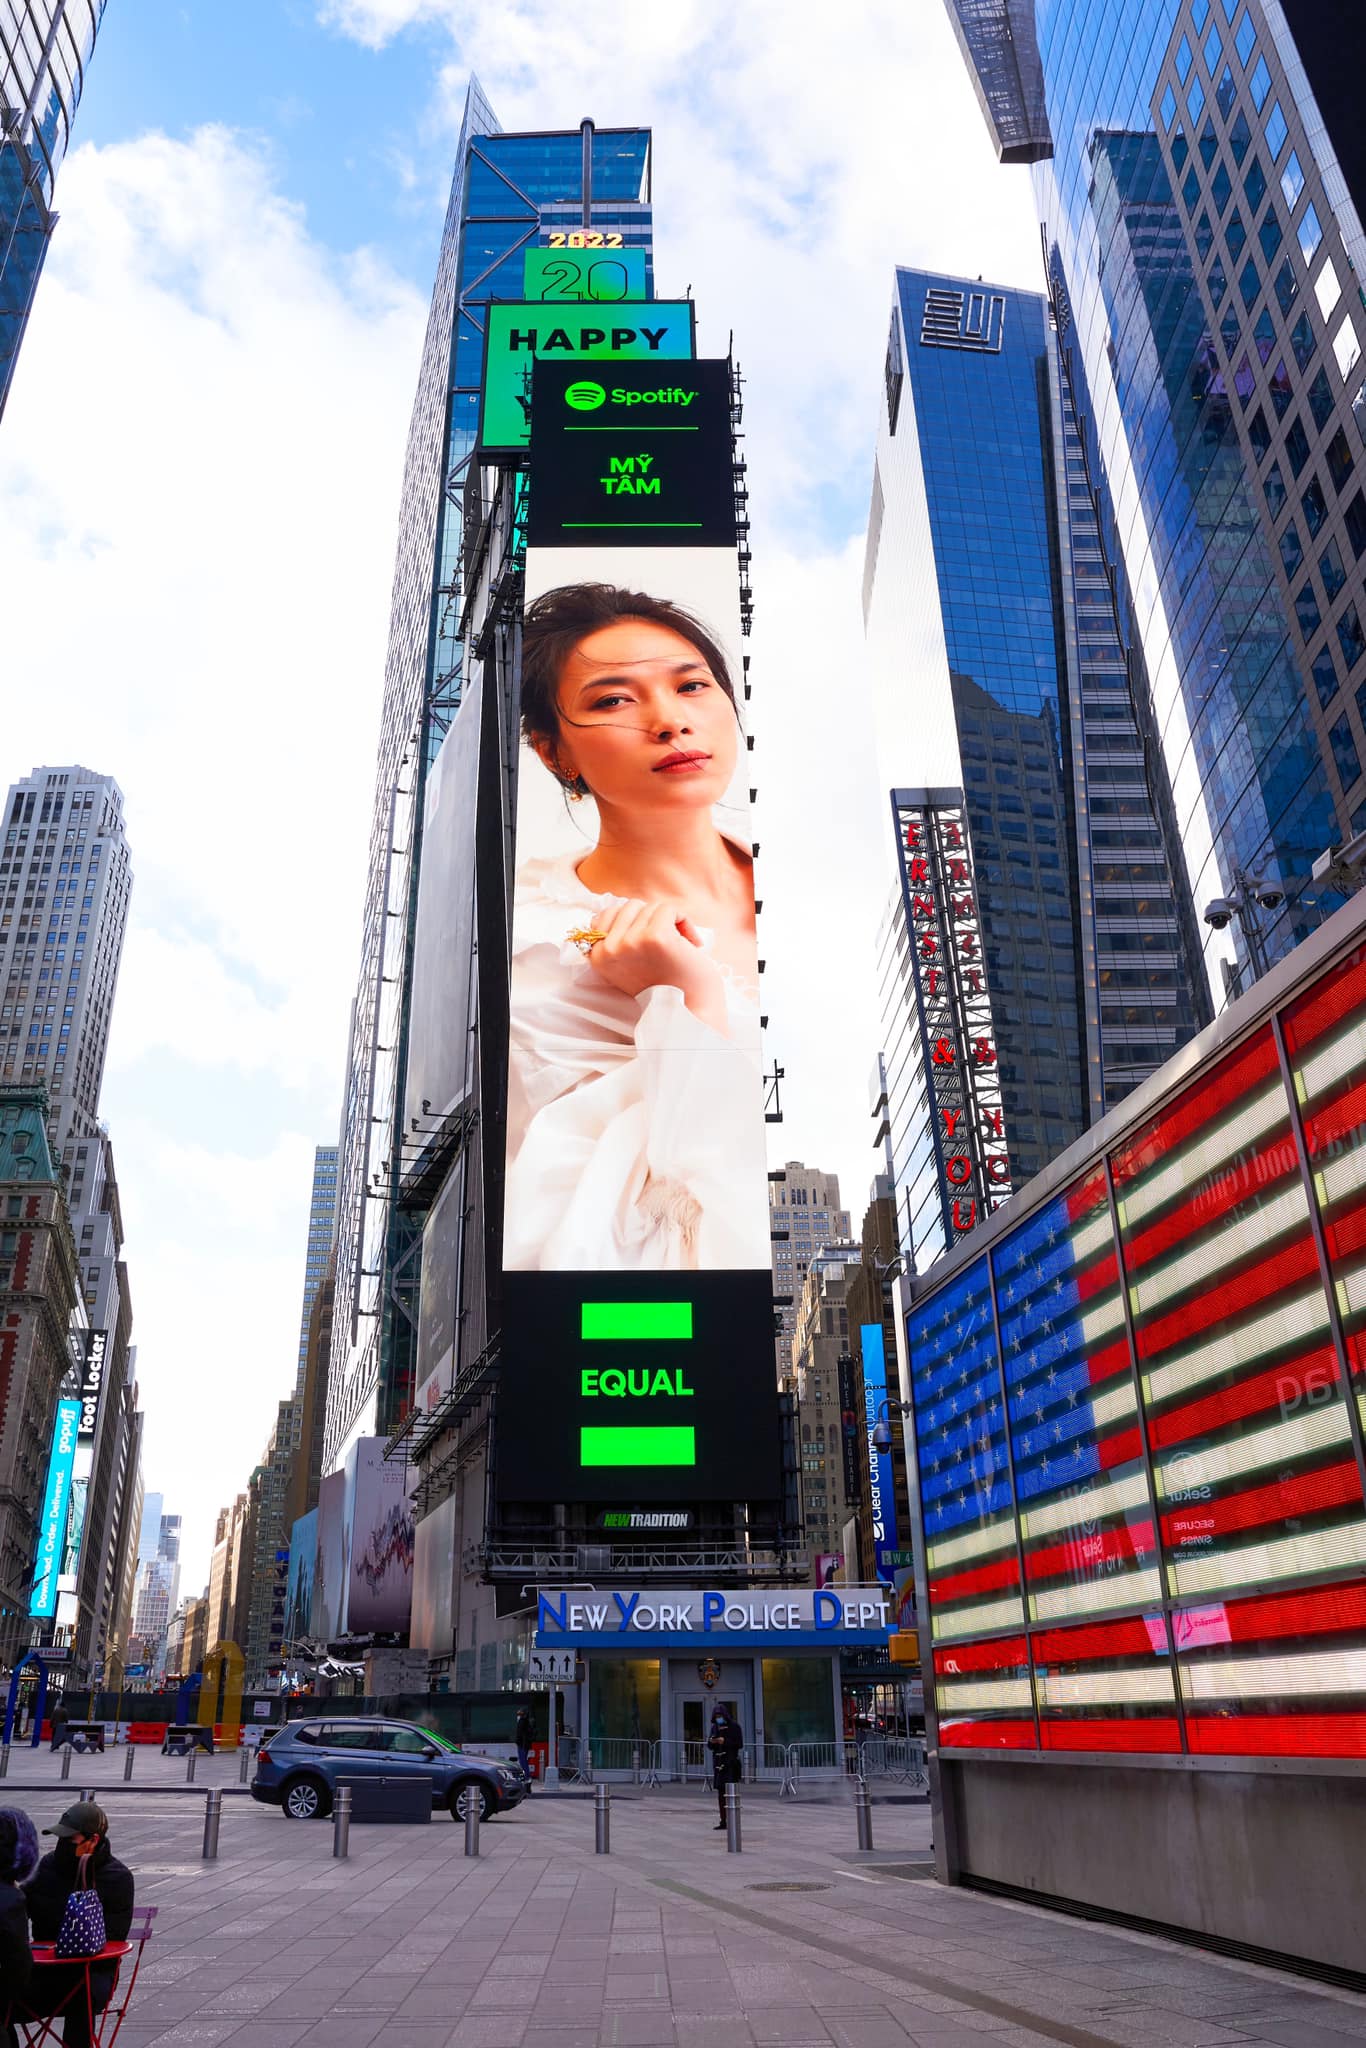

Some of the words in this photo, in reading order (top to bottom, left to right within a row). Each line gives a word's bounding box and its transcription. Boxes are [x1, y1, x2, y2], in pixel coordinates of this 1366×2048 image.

[549, 232, 623, 248] 2022
[542, 260, 628, 300] 20
[509, 328, 668, 351] HAPPY
[611, 388, 695, 406] Spotify
[610, 453, 654, 473] MỸ
[600, 475, 661, 494] TÂM
[907, 823, 941, 995] ERNST
[581, 1369, 694, 1399] EQUAL
[78, 1395, 97, 1433] Foot
[58, 1408, 76, 1454] gopuff
[49, 1469, 65, 1518] Delivered.
[870, 1485, 882, 1521] Clear
[45, 1520, 58, 1552] Order.
[892, 1552, 901, 1564] W
[538, 1592, 608, 1632] NEW
[613, 1592, 693, 1632] YORK
[703, 1592, 800, 1632] POLICE
[814, 1592, 890, 1632] DEPT
